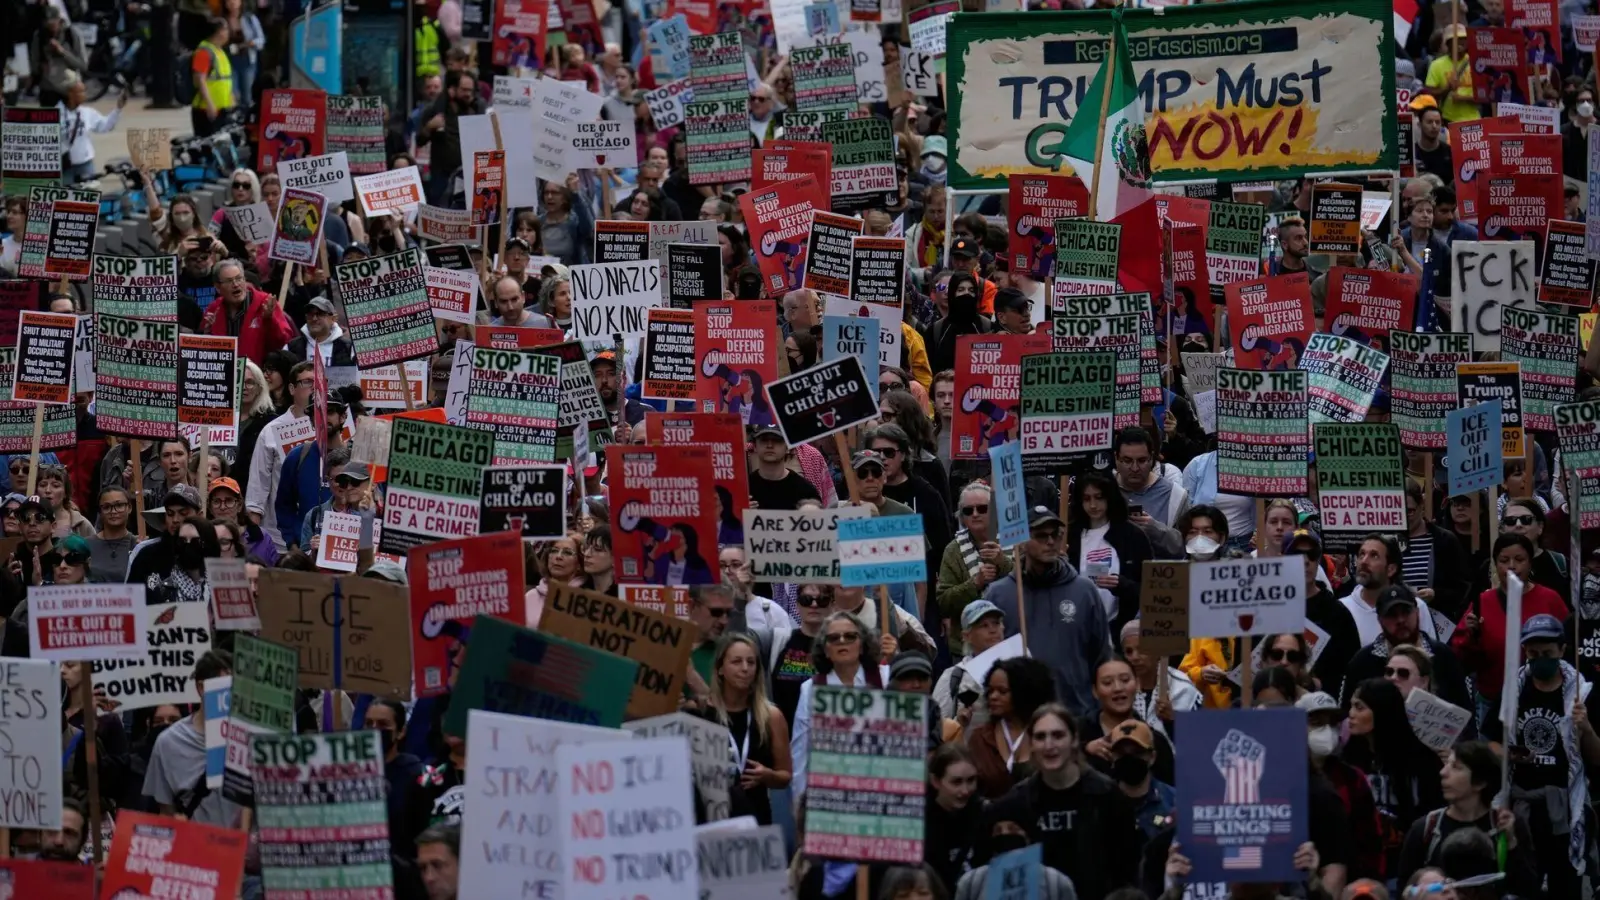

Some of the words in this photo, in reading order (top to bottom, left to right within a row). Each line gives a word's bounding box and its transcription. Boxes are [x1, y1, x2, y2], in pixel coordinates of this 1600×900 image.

[792, 50, 822, 63] STOP
[827, 47, 850, 59] THE
[1076, 34, 1262, 61] RefseFascism.org
[1217, 58, 1333, 109] Must
[578, 124, 596, 132] ICE
[599, 124, 620, 132] OUT
[1150, 108, 1303, 161] NOW!
[3, 135, 58, 144] REFERENDUM
[572, 138, 630, 147] CHICAGO
[4, 152, 23, 160] OVER
[27, 153, 58, 161] POLICE
[289, 161, 308, 172] ICE
[311, 158, 332, 169] OUT
[286, 170, 344, 188] CHICAGO
[1490, 186, 1515, 197] STOP
[338, 256, 384, 282] STOP
[388, 251, 417, 271] THE
[1457, 249, 1528, 292] FCK
[340, 278, 373, 292] TRUMP
[377, 267, 422, 283] AGENDA!
[672, 271, 700, 279] TRUMP
[572, 269, 600, 300] NO
[606, 266, 658, 296] NAZIS
[673, 279, 704, 287] FASCIST
[673, 287, 704, 296] REGIME
[1241, 292, 1268, 306] STOP
[100, 316, 138, 338] STOP
[144, 323, 175, 341] THE
[573, 307, 600, 337] NO
[707, 315, 732, 329] STOP
[23, 326, 40, 335] SHUT
[42, 328, 59, 337] DOWN
[61, 329, 73, 338] ICE!
[708, 329, 764, 339] DEPORTATIONS
[838, 325, 866, 340] ICE
[29, 339, 38, 347] NO
[40, 339, 65, 349] MILITARY
[99, 334, 127, 347] TRUMP
[132, 339, 176, 351] AGENDA!
[727, 339, 764, 352] DEFEND
[836, 340, 867, 355] OUT
[28, 346, 65, 357] OCCUPATION!
[708, 353, 765, 364] IMMIGRANTS
[24, 359, 38, 368] Shut
[40, 360, 54, 370] Down
[55, 361, 65, 370] The
[1025, 356, 1050, 367] FROM
[21, 374, 41, 383] Fascist
[43, 375, 66, 385] Regime!
[26, 367, 43, 376] Whole
[45, 368, 62, 378] Trump
[786, 376, 810, 395] ICE
[811, 364, 842, 388] OUT
[1024, 365, 1112, 386] CHICAGO
[1478, 375, 1495, 384] The
[811, 383, 825, 394] OF
[1099, 383, 1111, 394] TO
[1218, 389, 1252, 401] TRUMP
[1255, 391, 1305, 402] AGENDA!
[1465, 384, 1513, 399] Trump
[784, 380, 859, 416] CHICAGO
[1022, 396, 1111, 414] PALESTINE
[397, 421, 425, 434] FROM
[1023, 417, 1109, 434] OCCUPATION
[1462, 412, 1488, 432] ICE
[1317, 425, 1341, 436] FROM
[1461, 428, 1489, 446] OUT
[1024, 434, 1038, 449] IS
[1044, 433, 1054, 448] A
[1060, 432, 1108, 447] CRIME!
[1317, 438, 1398, 457] CHICAGO
[394, 433, 488, 466] CHICAGO
[1469, 444, 1483, 455] OF
[1001, 454, 1016, 474] ICE
[1389, 459, 1399, 469] TO
[390, 469, 481, 497] PALESTINE
[491, 472, 512, 484] ICE
[517, 471, 546, 484] OUT
[1003, 473, 1017, 490] OUT
[1320, 472, 1401, 487] PALESTINE
[510, 484, 525, 494] OF
[388, 493, 479, 520] OCCUPATION
[485, 492, 555, 507] CHICAGO
[1322, 496, 1401, 508] OCCUPATION
[387, 510, 401, 524] IS
[408, 513, 418, 528] A
[431, 517, 477, 537] CRIME!
[751, 516, 783, 531] ARE
[790, 516, 823, 531] YOU
[845, 522, 874, 534] THE
[879, 518, 918, 532] WHOLE
[1324, 513, 1336, 525] IS
[1343, 512, 1353, 525] A
[1357, 512, 1403, 525] CRIME!
[750, 538, 790, 553] WE'RE
[796, 538, 832, 552] STILL
[751, 559, 792, 576] LAND
[794, 564, 809, 577] OF
[812, 564, 829, 576] THE
[1152, 567, 1174, 578] NO
[1210, 566, 1240, 580] ICE
[1250, 562, 1282, 577] OUT
[1238, 578, 1254, 588] OF
[1201, 585, 1296, 605] CHICAGO
[48, 618, 78, 630] I.C.E.
[82, 616, 100, 630] OUT
[105, 616, 124, 628] OF
[553, 590, 682, 648] LIBERATION
[48, 630, 126, 646] EVERYWHERE
[590, 628, 635, 656] NOT
[150, 650, 194, 666] THIS
[234, 652, 294, 691] CHICAGO
[94, 672, 188, 697] COUNTRY
[814, 690, 872, 714] STOP
[882, 693, 921, 720] THE
[254, 739, 318, 764] STOP
[327, 734, 375, 760] THE
[8, 754, 41, 790] TO
[572, 760, 614, 796] NO
[622, 756, 664, 786] ICE
[1193, 804, 1292, 820] REJECTING
[572, 806, 605, 840] NO
[1214, 821, 1270, 834] KINGS
[573, 857, 605, 884] NO
[614, 850, 692, 883] TRUMP
